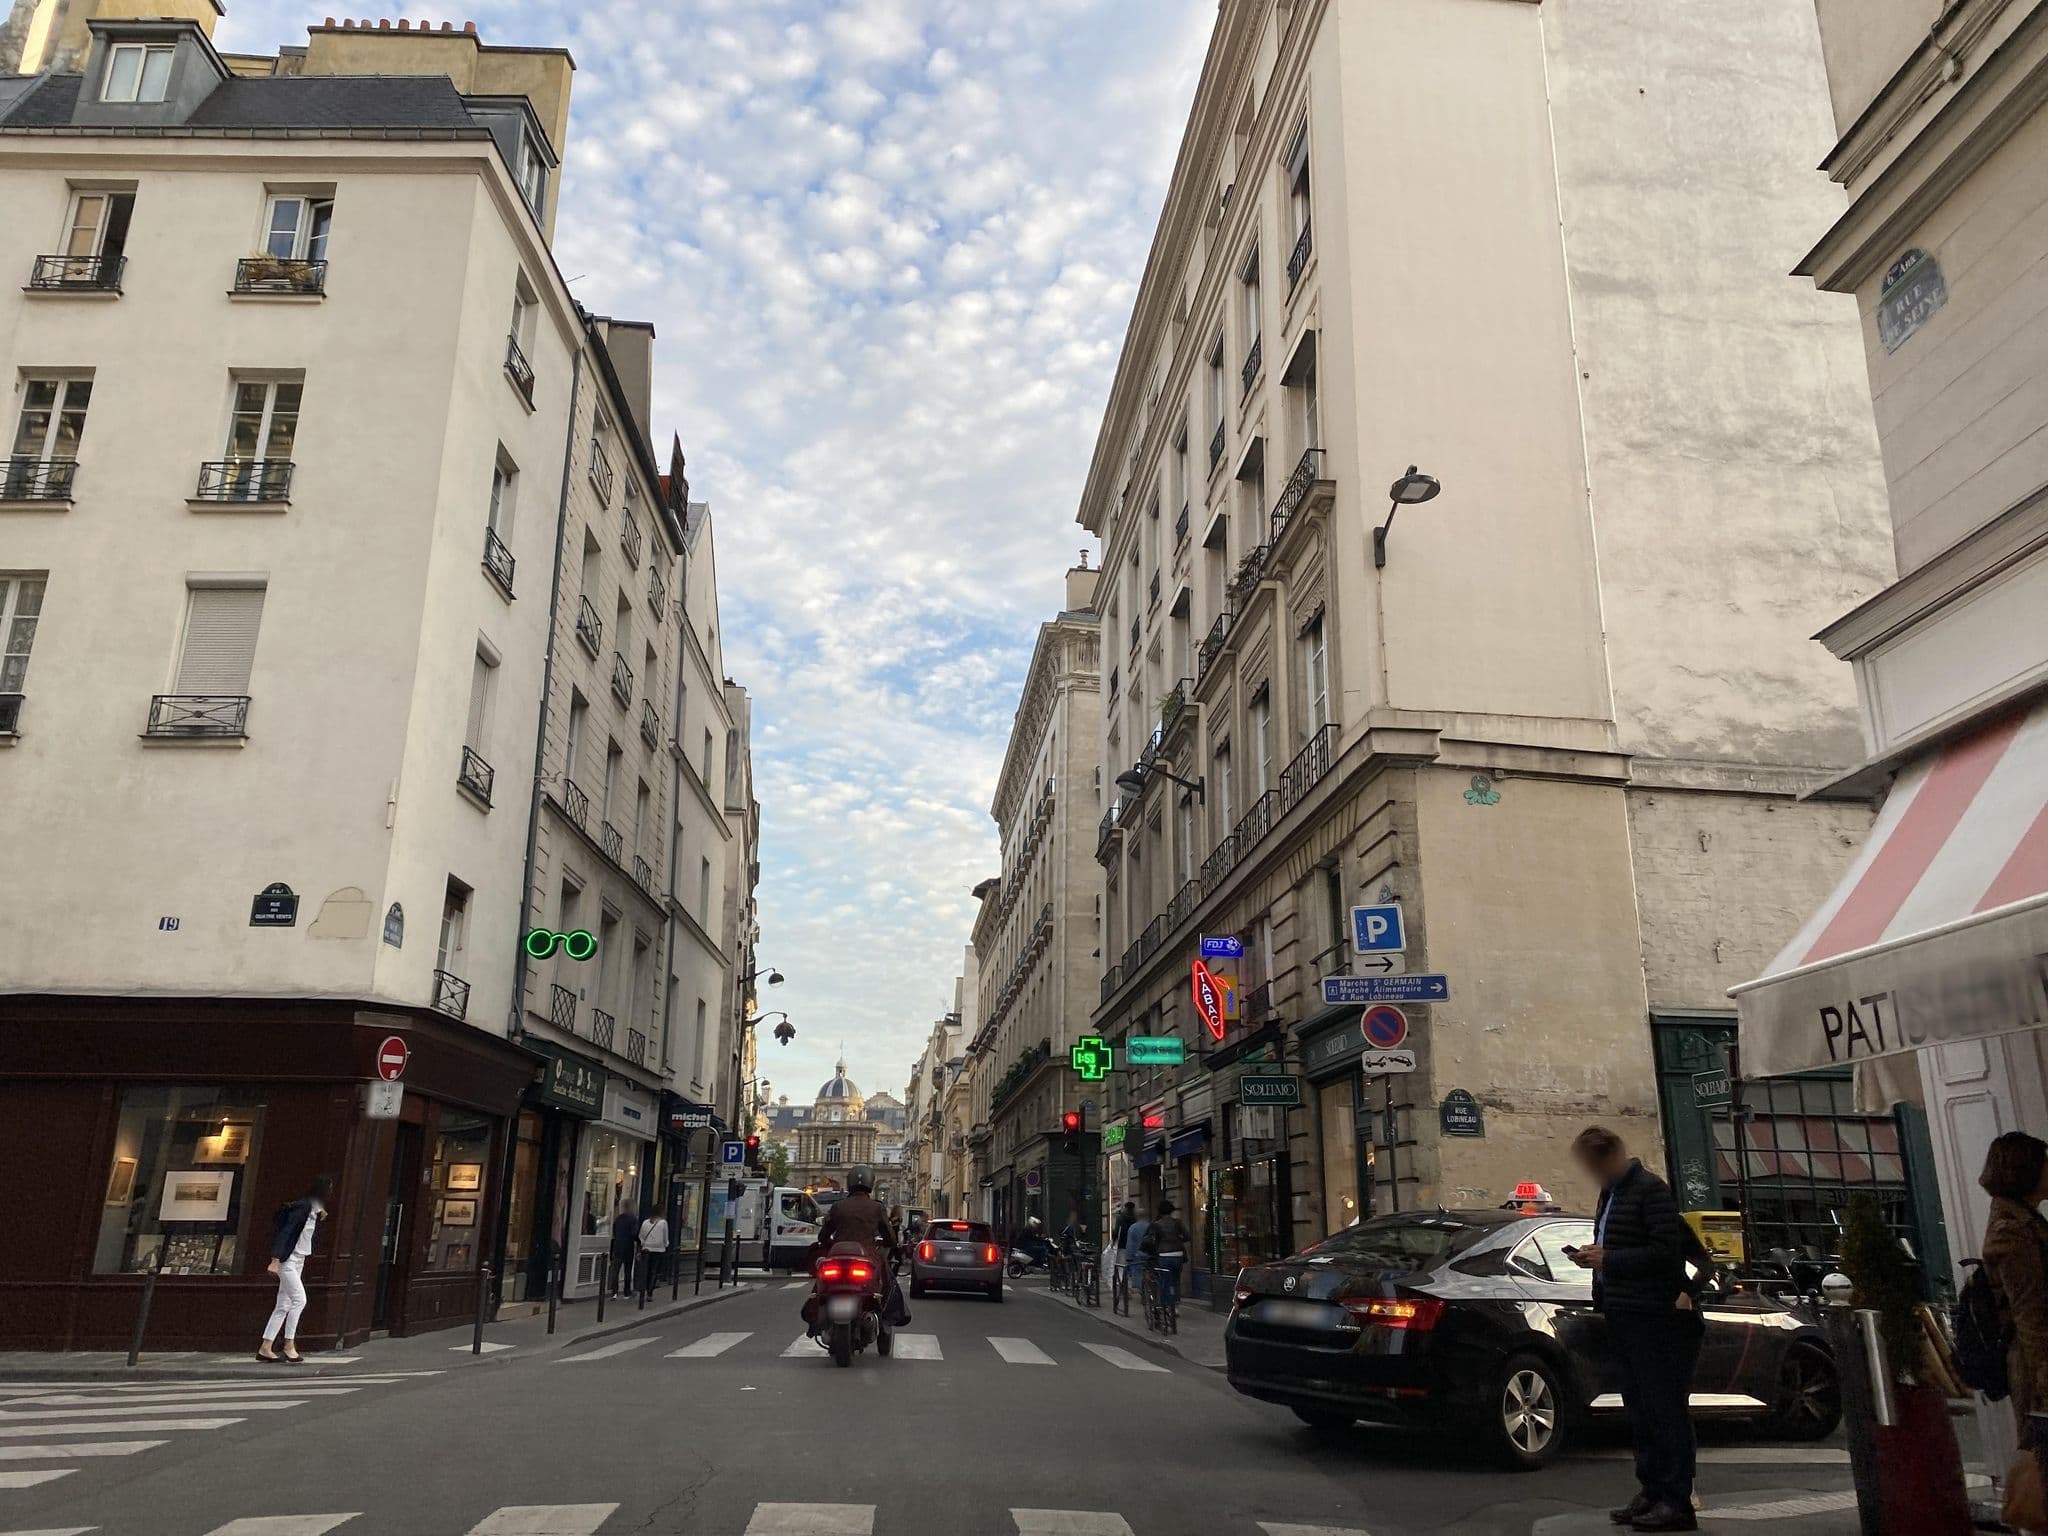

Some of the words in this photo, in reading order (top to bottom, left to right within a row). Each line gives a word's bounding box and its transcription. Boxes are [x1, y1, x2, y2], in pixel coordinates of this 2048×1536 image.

[163, 917, 178, 931] 19
[1366, 915, 1388, 944] P
[1206, 940, 1224, 949] FDJ
[1384, 978, 1421, 986] GERMAIN
[1374, 985, 1422, 993] Alimentaire
[1198, 971, 1220, 1026] TABAC
[1350, 993, 1364, 1001] Rue
[1369, 993, 1404, 1001] Lobineau
[1454, 1107, 1468, 1115] RUE
[671, 1113, 711, 1121] michel
[1446, 1115, 1477, 1123] LOBINEAU
[728, 1146, 738, 1160] P
[1517, 1185, 1535, 1194] TAXI
